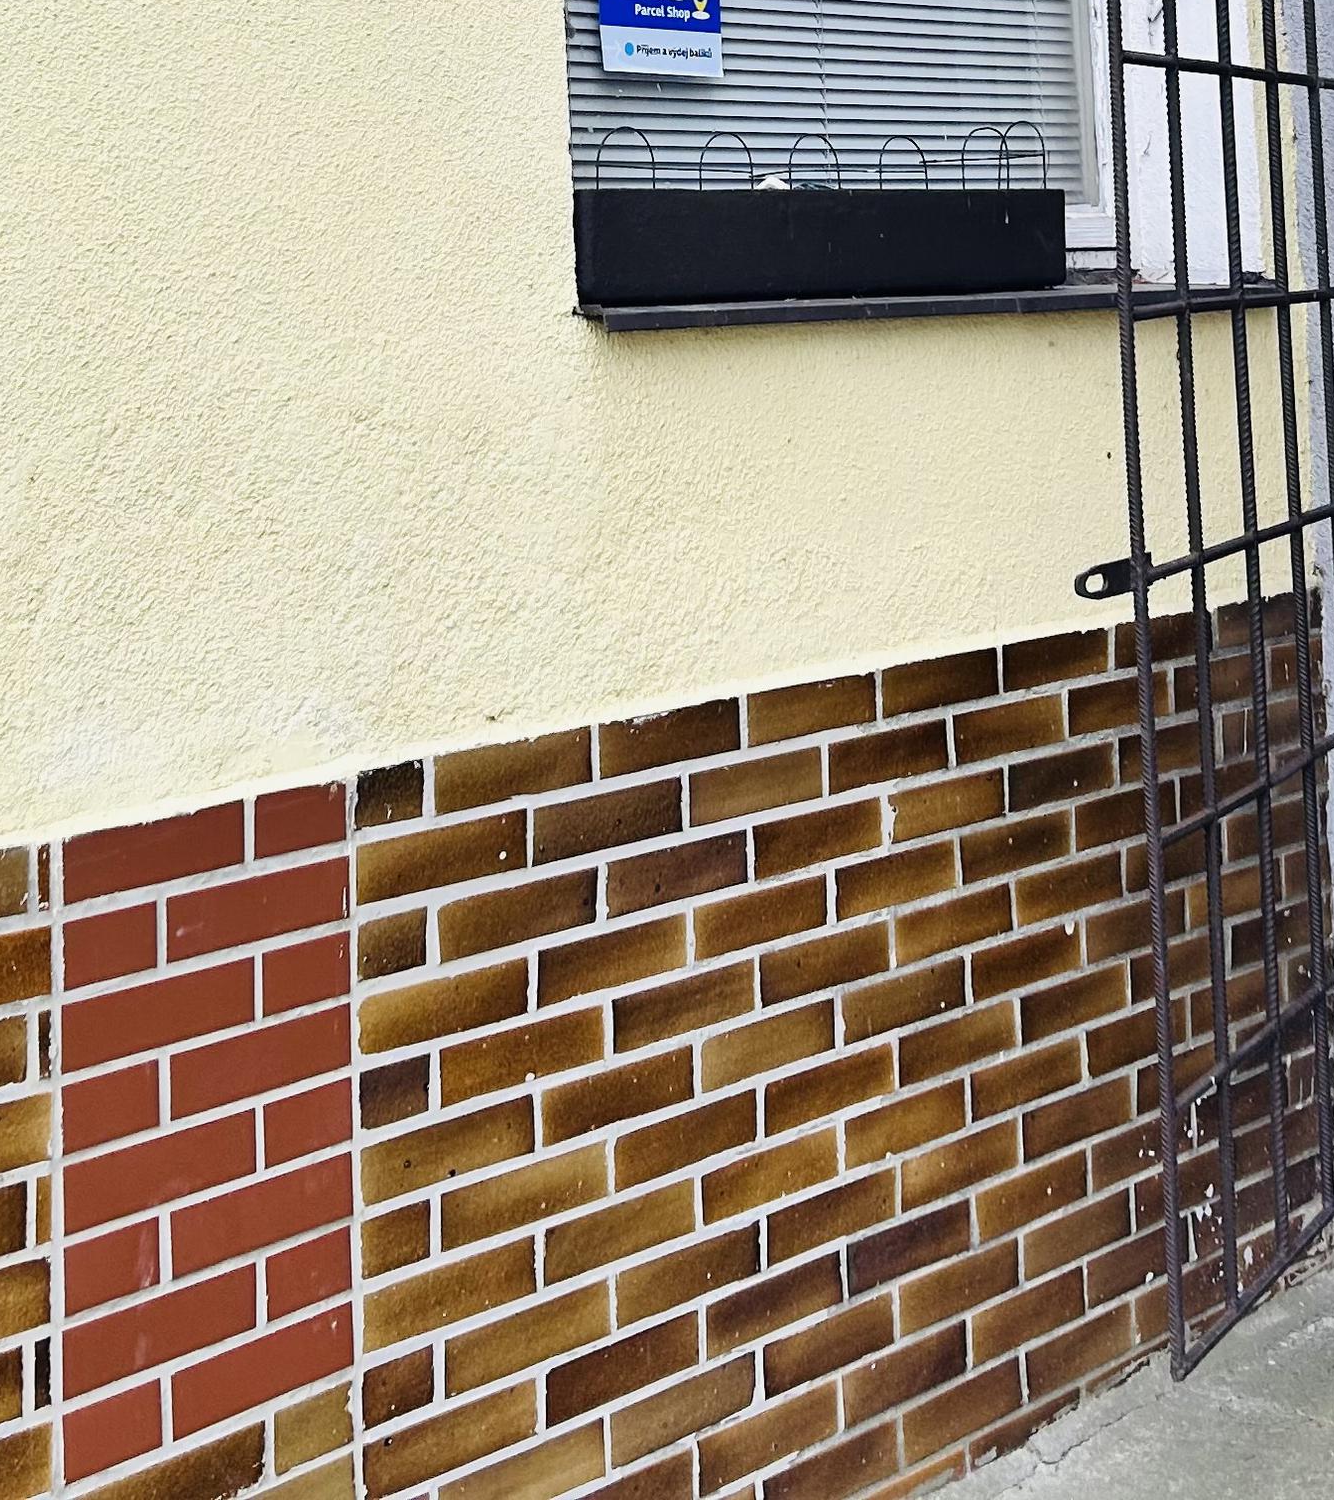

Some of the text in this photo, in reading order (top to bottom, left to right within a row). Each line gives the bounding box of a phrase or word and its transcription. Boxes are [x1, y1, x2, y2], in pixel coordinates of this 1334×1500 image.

[634, 3, 691, 23] Parcel Shop
[662, 48, 668, 56] a
